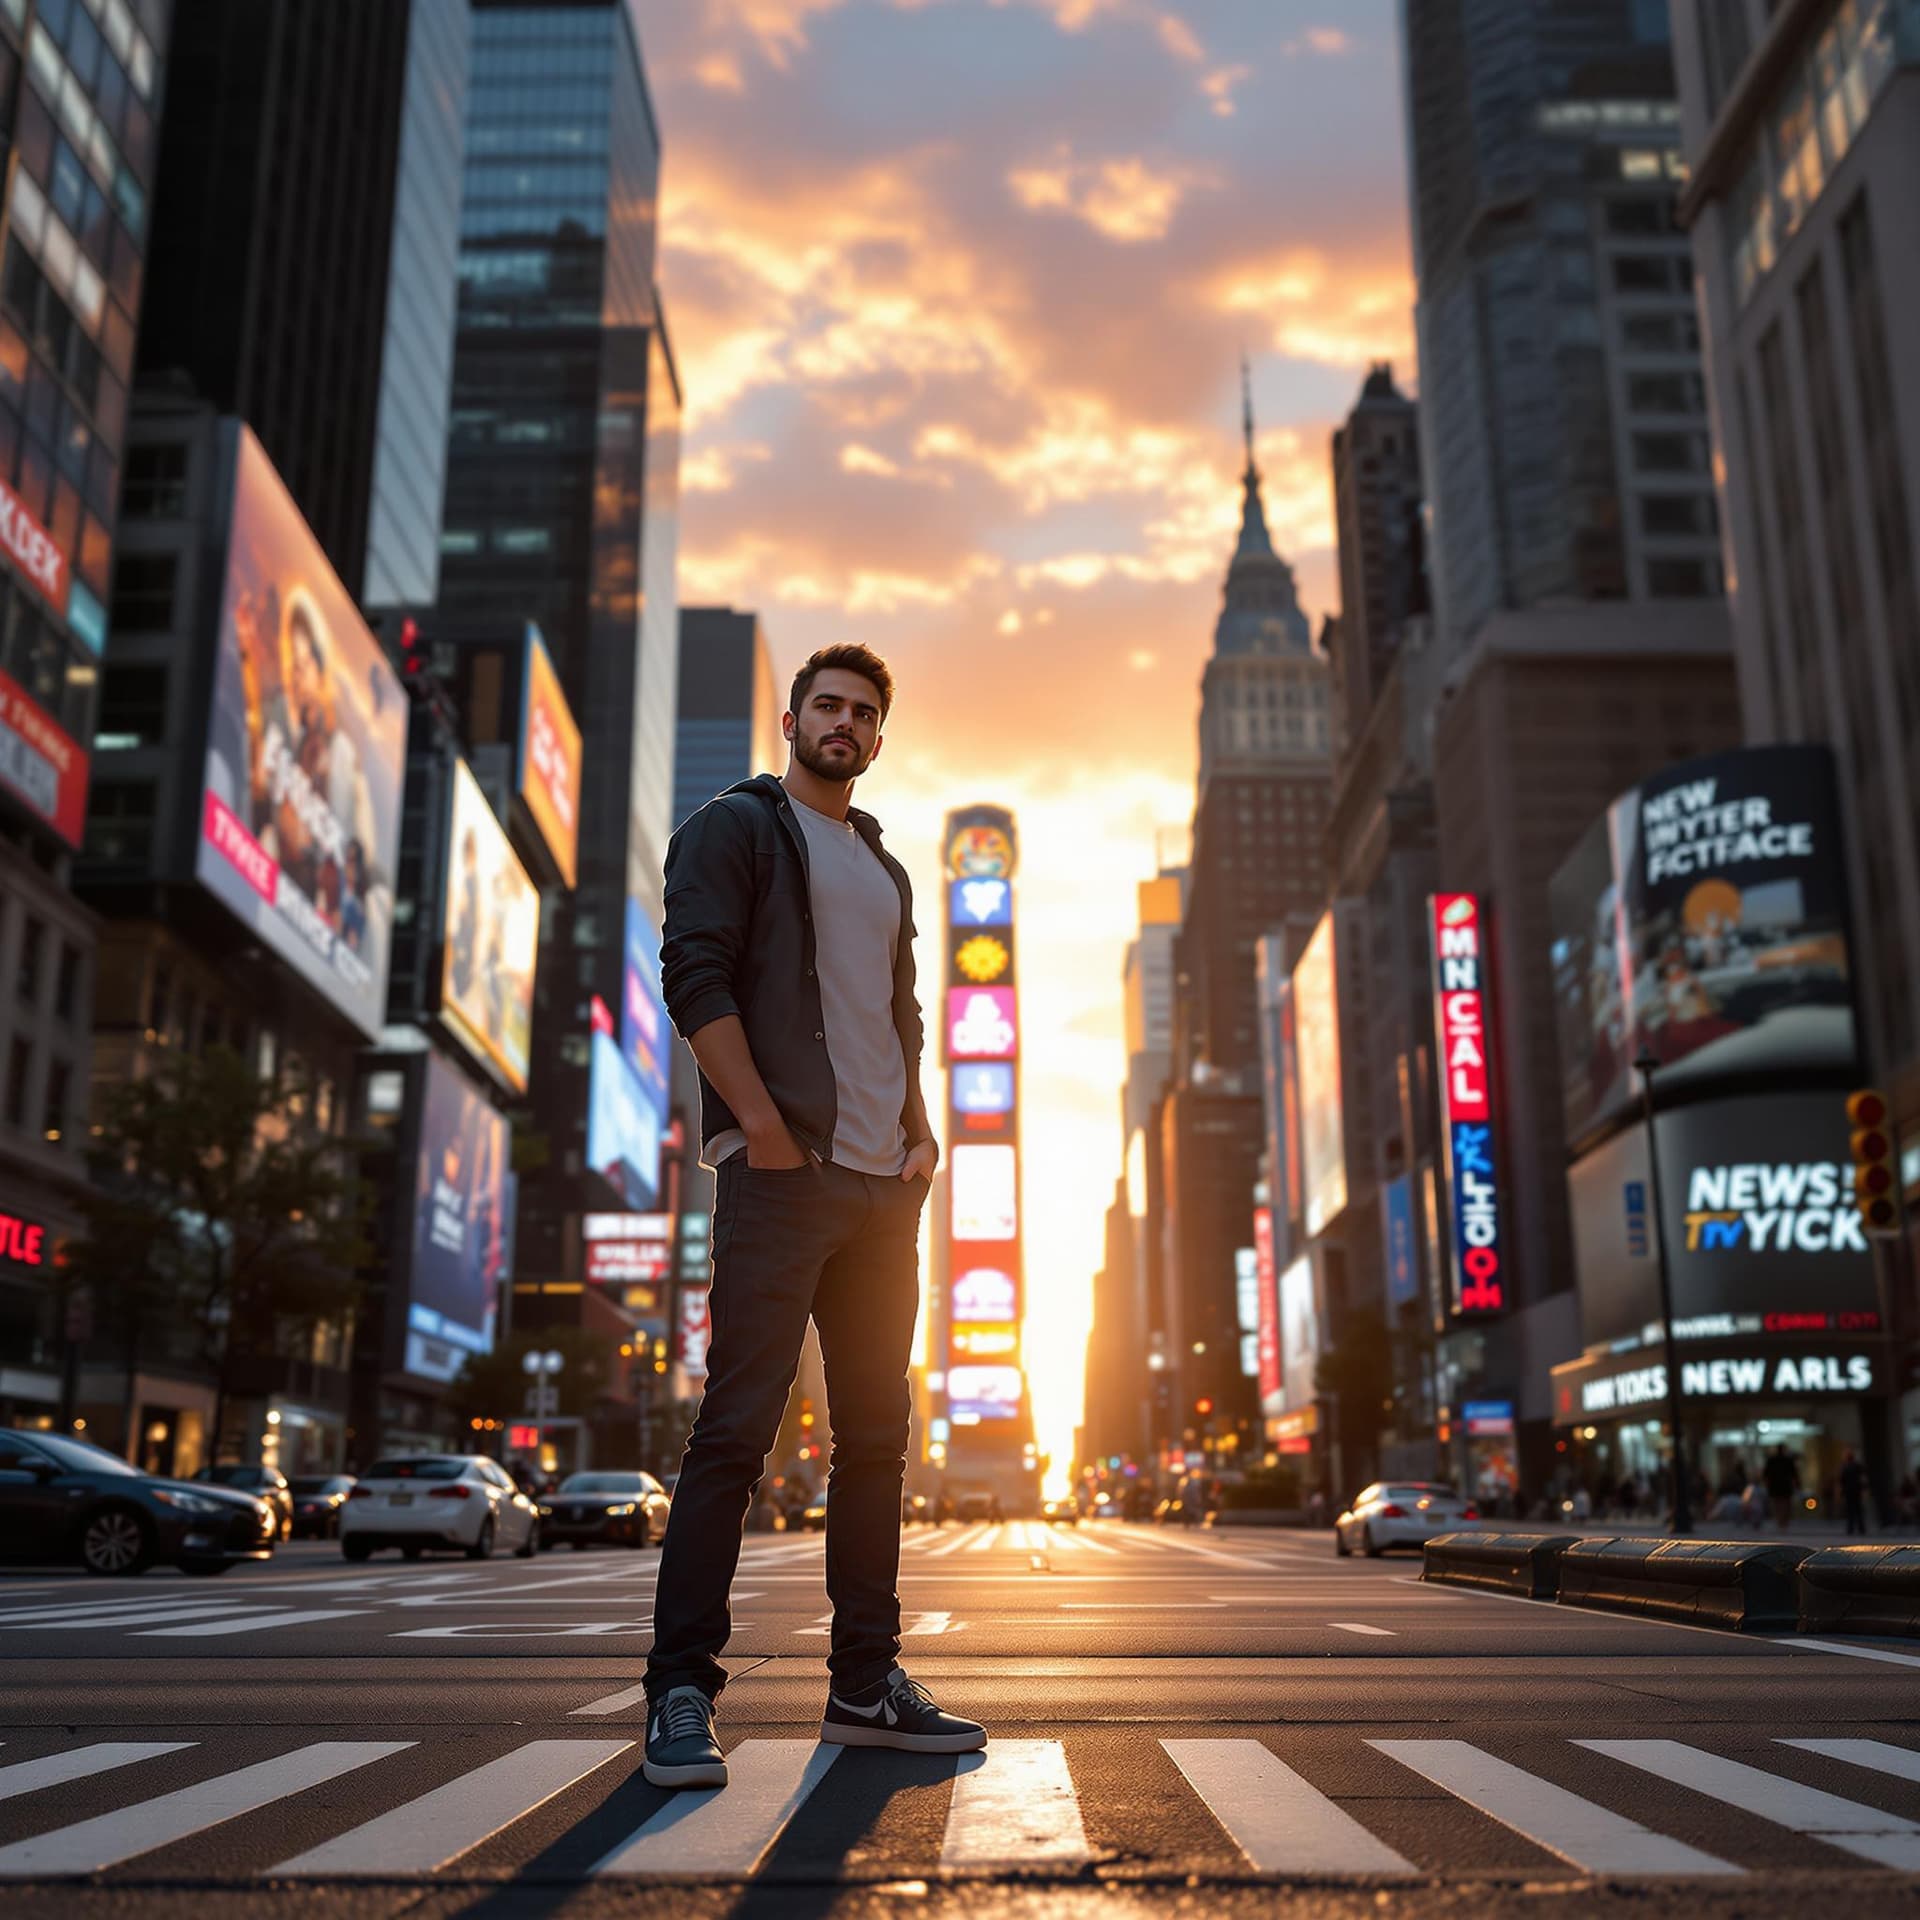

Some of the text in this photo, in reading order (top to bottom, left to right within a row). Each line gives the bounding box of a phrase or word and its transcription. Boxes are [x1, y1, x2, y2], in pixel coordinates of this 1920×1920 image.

[1643, 777, 1718, 827] NEW
[1682, 1360, 1766, 1396] NEW
[1773, 1356, 1872, 1391] ARLS
